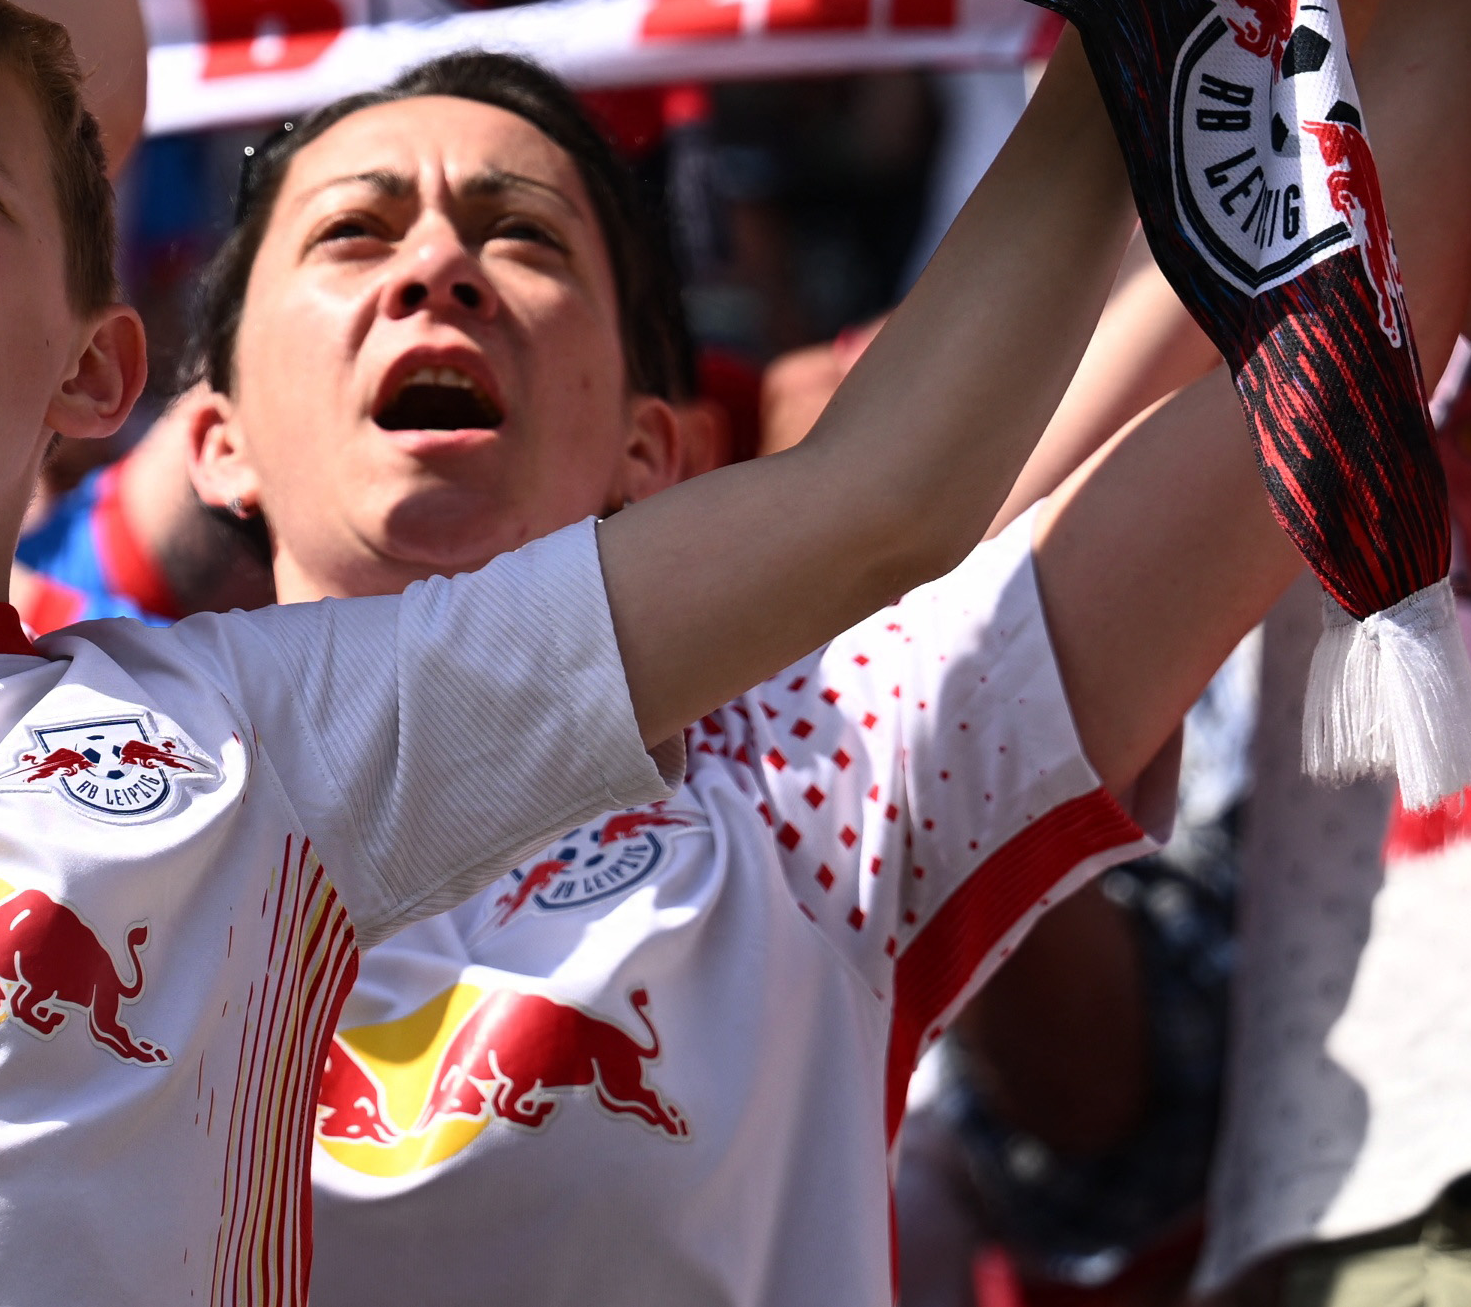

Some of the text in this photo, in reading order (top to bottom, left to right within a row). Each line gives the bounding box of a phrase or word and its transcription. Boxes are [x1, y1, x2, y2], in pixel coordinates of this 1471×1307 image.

[1196, 73, 1254, 131] RB
[76, 773, 160, 806] RB LEIPZIG
